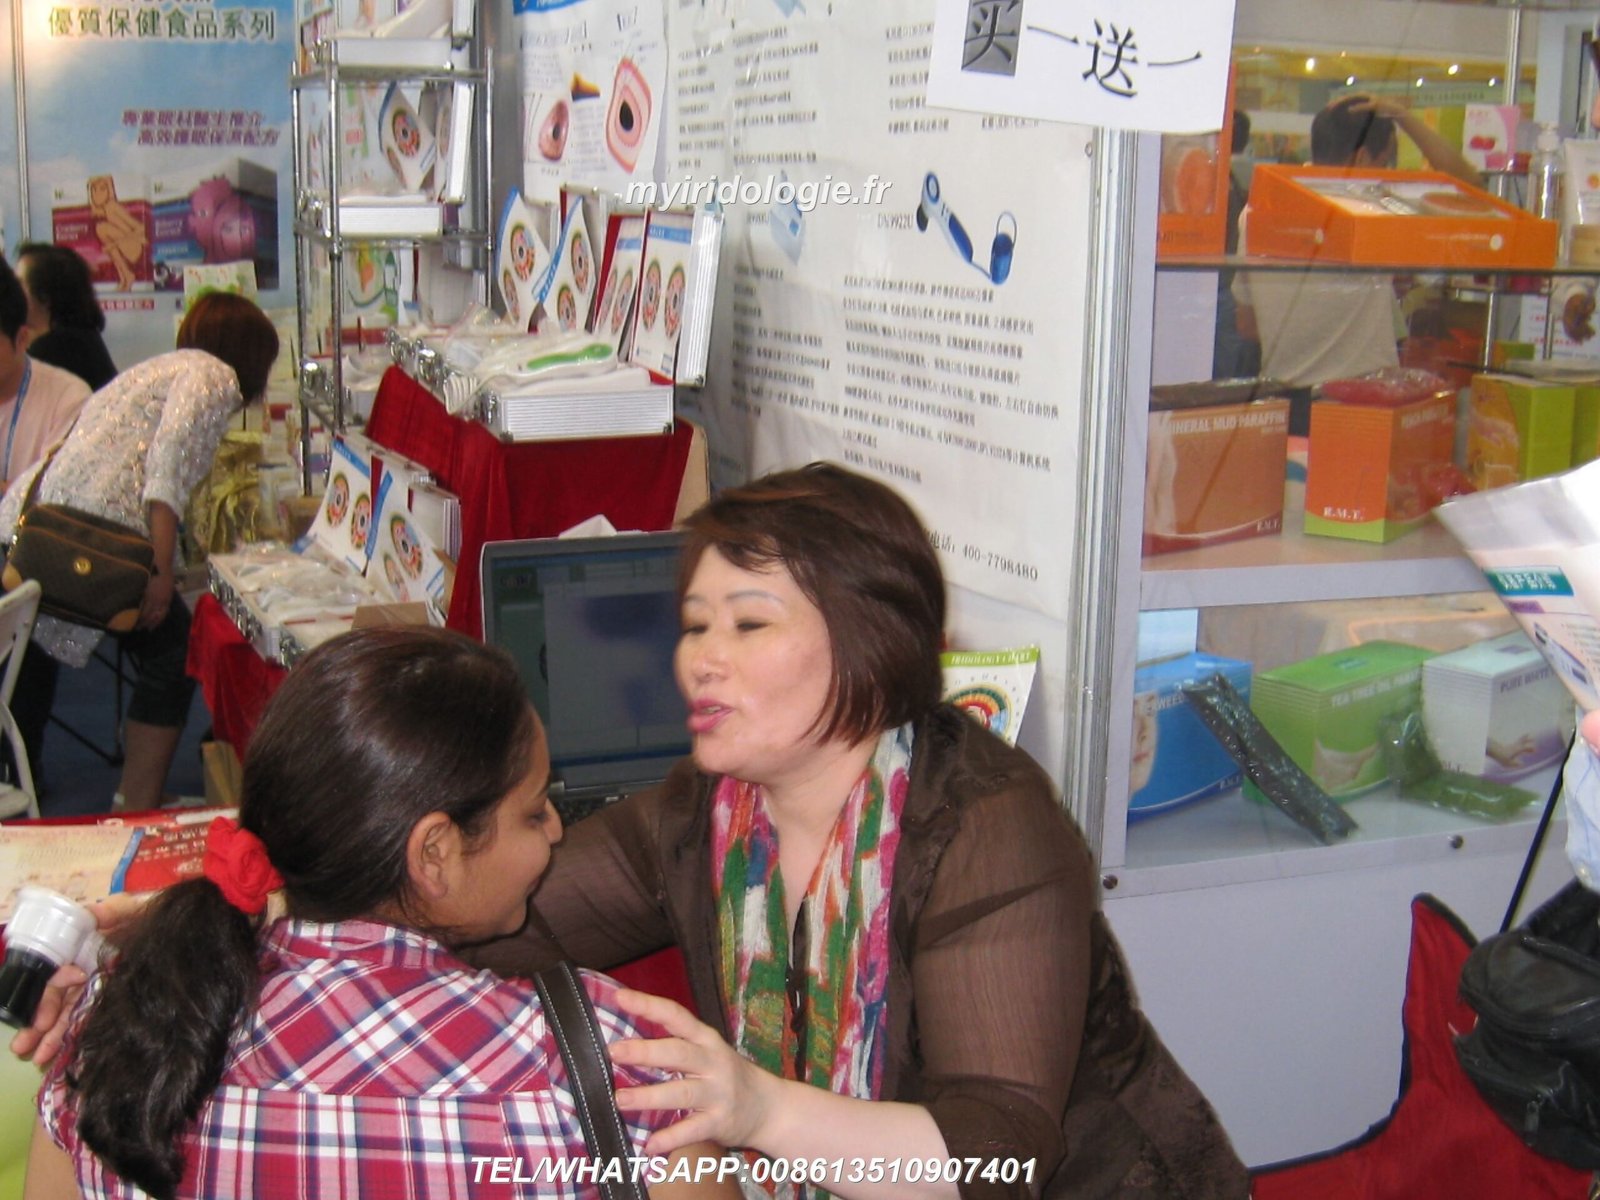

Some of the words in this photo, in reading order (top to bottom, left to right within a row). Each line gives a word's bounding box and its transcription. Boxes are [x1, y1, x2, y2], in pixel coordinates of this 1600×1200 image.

[49, 7, 276, 40] 優質保健食品系列
